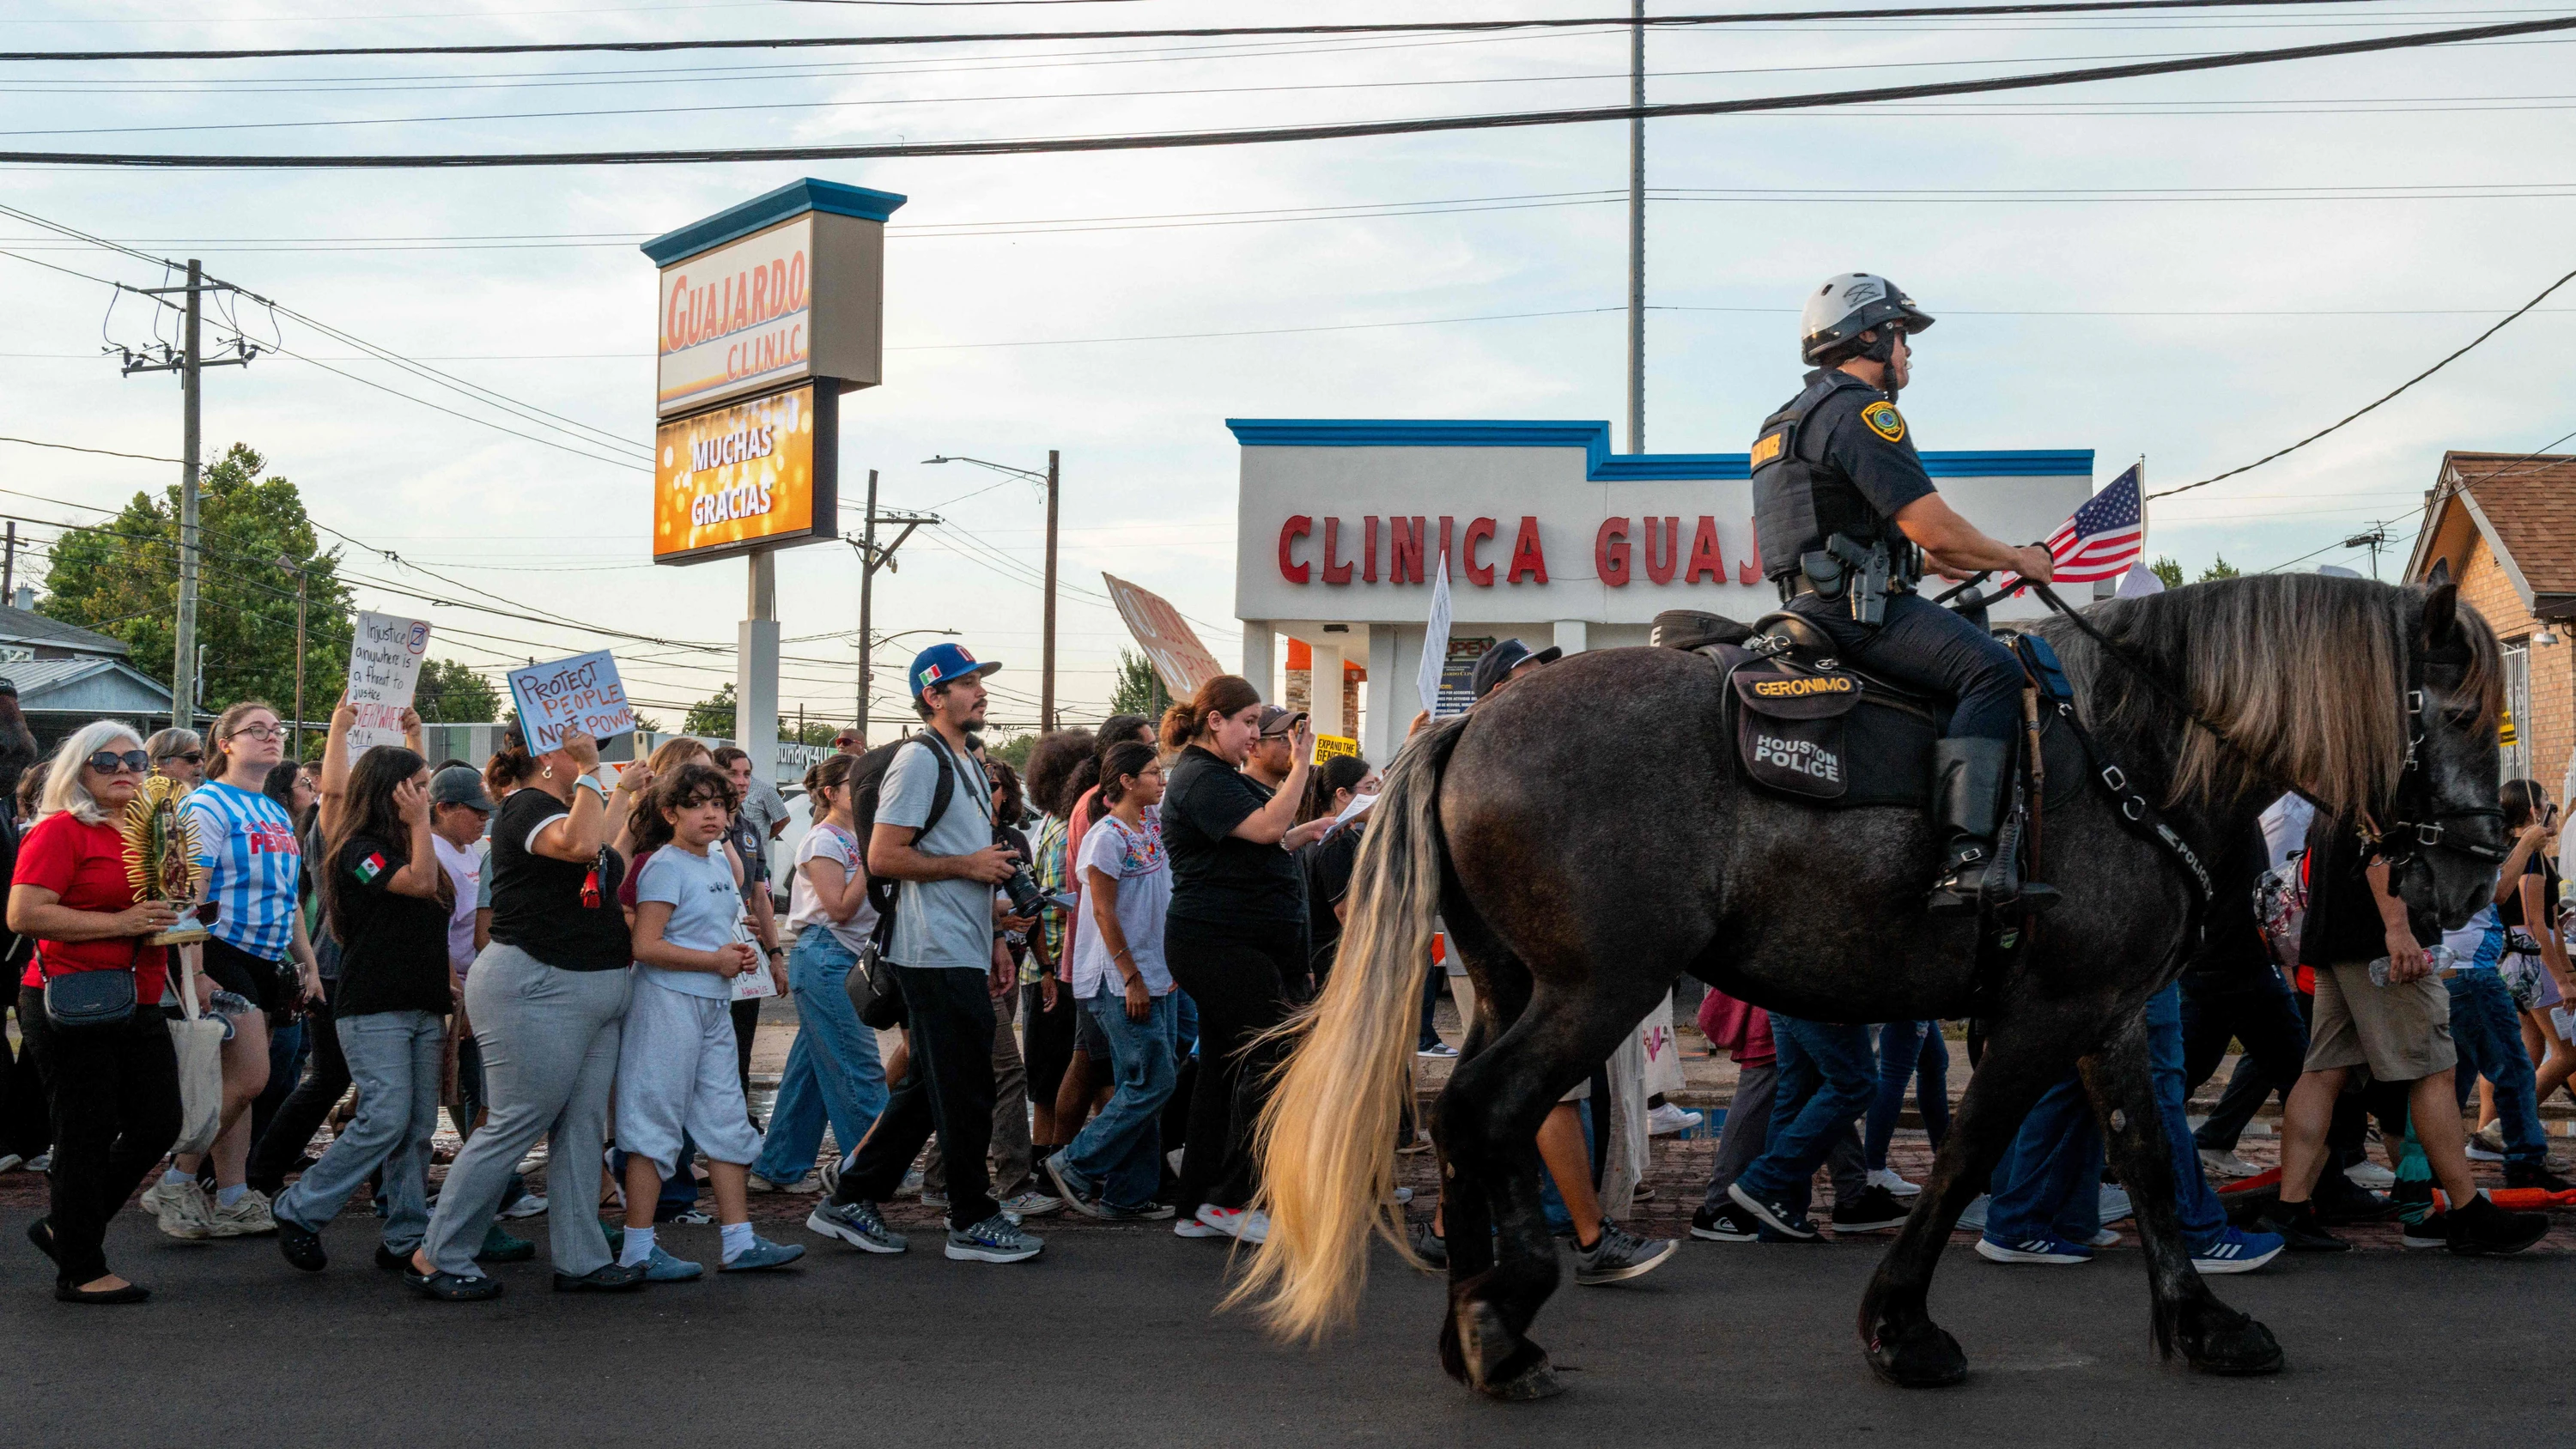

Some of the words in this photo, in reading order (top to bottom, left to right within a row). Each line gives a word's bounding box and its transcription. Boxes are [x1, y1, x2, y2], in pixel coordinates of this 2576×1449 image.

[666, 249, 805, 353] GUAJARDO
[726, 323, 802, 383] CLINIC
[691, 424, 773, 473] MUCHAS
[690, 482, 772, 527] GRACIAS
[1279, 515, 1549, 586] CLINICA
[1109, 580, 1157, 638] NO
[355, 646, 400, 668] anywhere
[402, 654, 411, 668] is
[1143, 644, 1192, 694] NO
[353, 671, 361, 682] a
[366, 665, 390, 687] threat
[393, 671, 404, 689] to
[353, 685, 381, 701] justice
[518, 660, 597, 705] PROTECT
[1754, 677, 1851, 696] GERONIMO
[351, 702, 407, 735] VERYWHER
[542, 683, 623, 718] PEOPLE
[538, 714, 579, 747] NOT
[1318, 738, 1342, 752] EXPAND
[1343, 743, 1355, 754] THE
[1754, 745, 1839, 783] POLICE
[1757, 734, 1838, 767] HOUSTON
